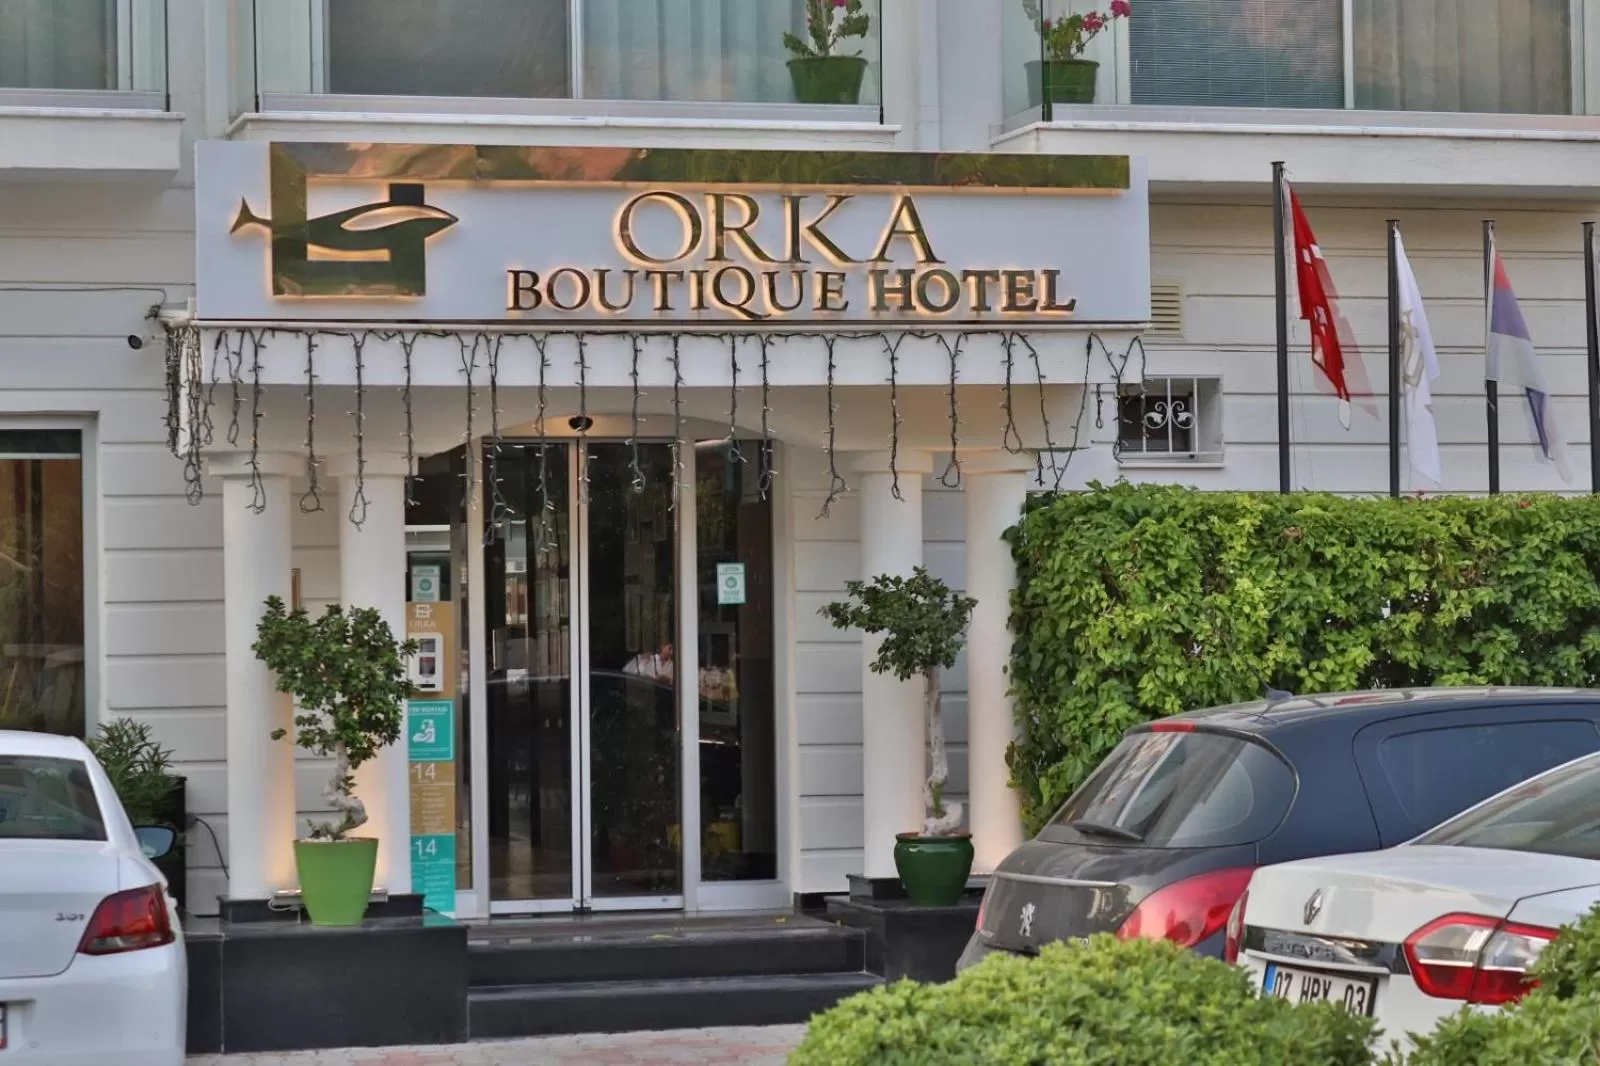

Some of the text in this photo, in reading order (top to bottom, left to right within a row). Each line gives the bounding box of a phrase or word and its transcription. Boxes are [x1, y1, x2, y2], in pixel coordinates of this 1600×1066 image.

[619, 191, 945, 264] ORKA
[507, 266, 1077, 319] BOUTIQUE HOTEL
[413, 762, 437, 781] 14
[414, 838, 437, 857] 14
[1344, 983, 1366, 1015] 03
